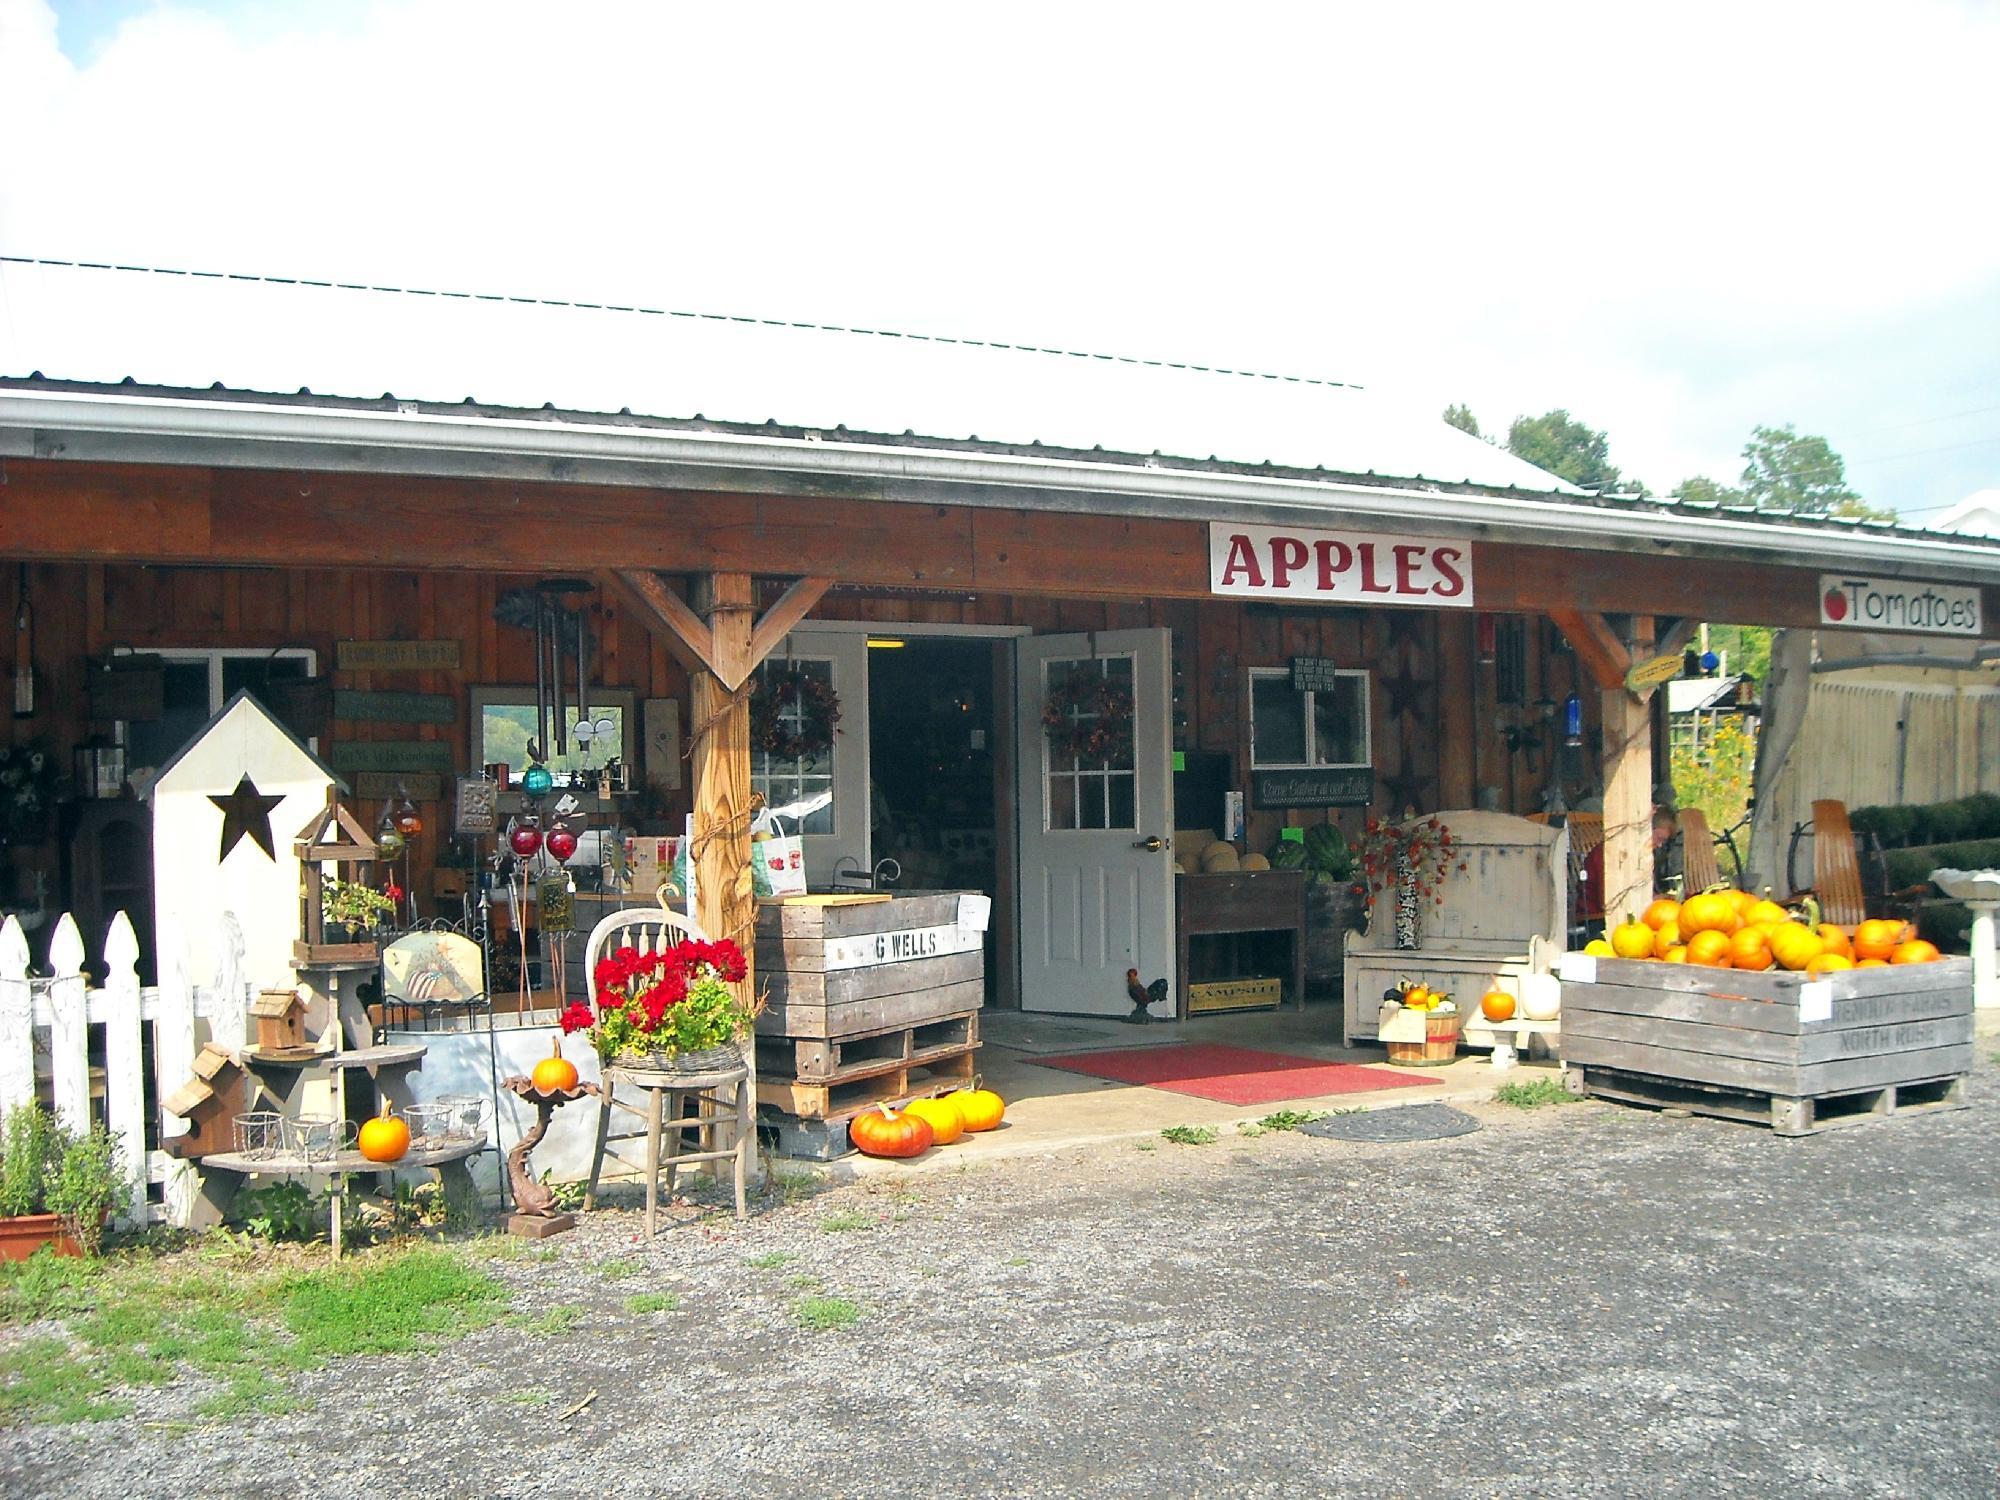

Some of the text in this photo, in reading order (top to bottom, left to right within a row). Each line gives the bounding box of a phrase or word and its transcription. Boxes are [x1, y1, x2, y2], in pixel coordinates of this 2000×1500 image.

[1221, 534, 1465, 597] APPLES
[1842, 580, 1977, 629] Tomatoes
[875, 932, 936, 960] G WELLS
[1840, 1027, 1890, 1051] NORTH
